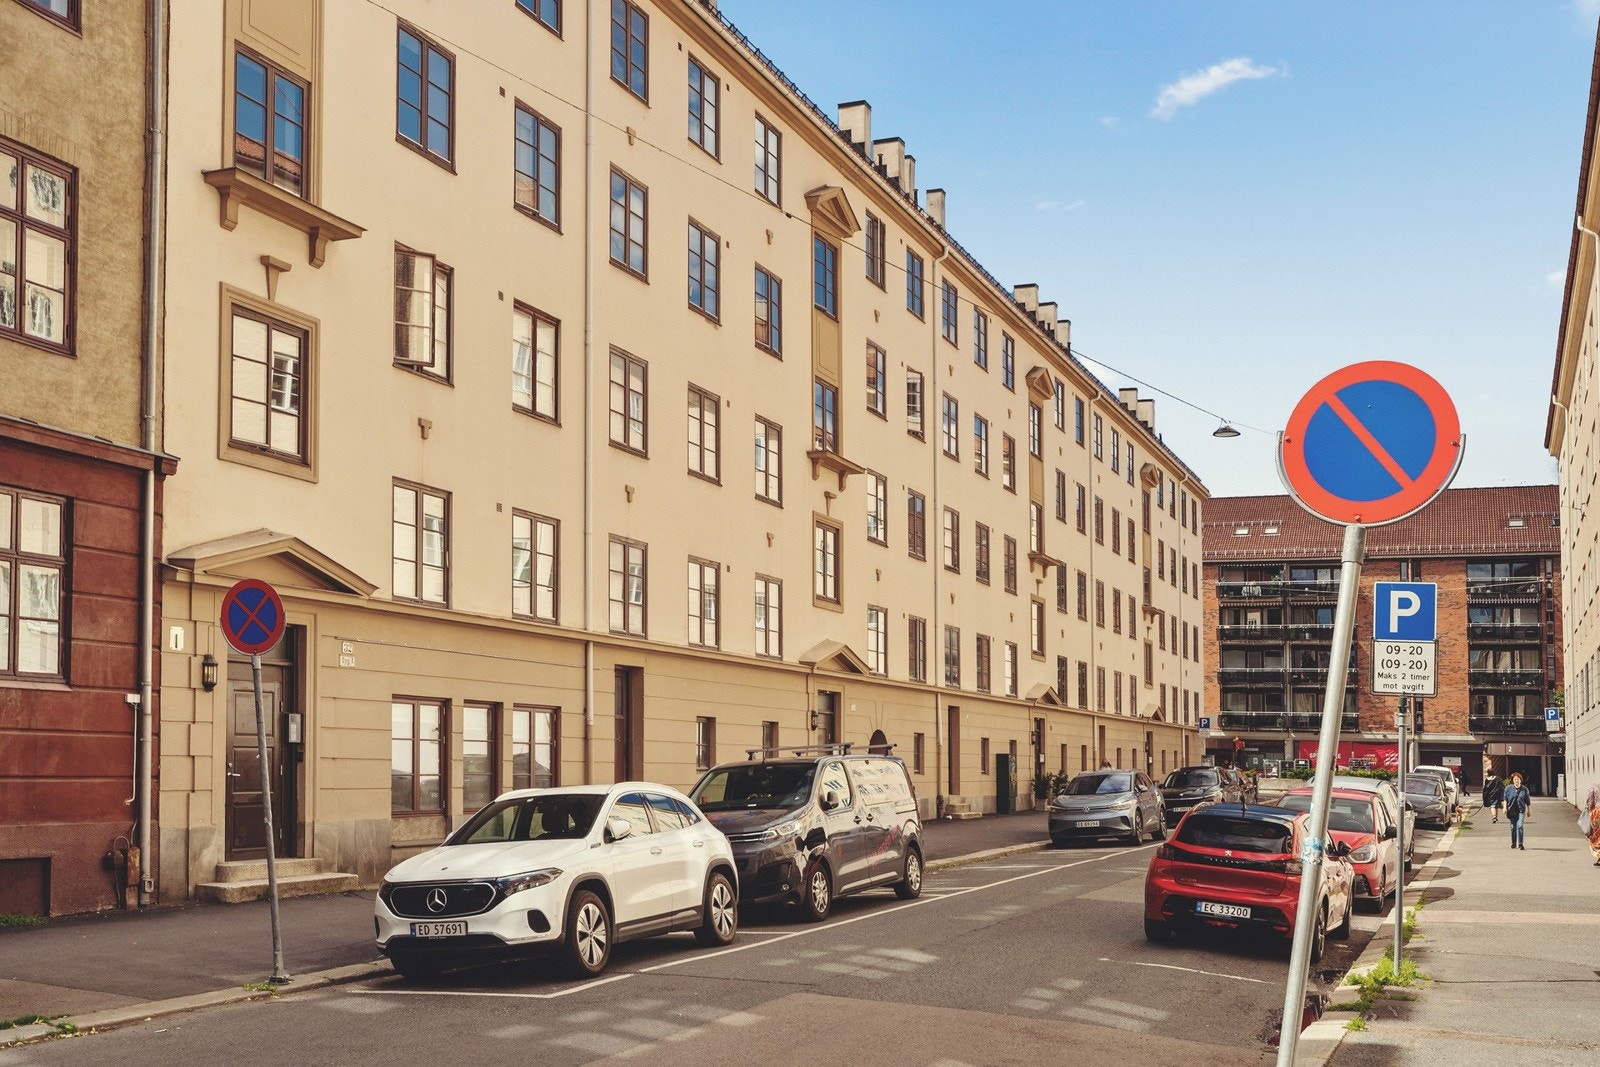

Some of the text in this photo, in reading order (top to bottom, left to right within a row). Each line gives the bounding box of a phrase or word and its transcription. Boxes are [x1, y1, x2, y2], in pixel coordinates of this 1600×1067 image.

[1389, 590, 1421, 633] P
[1377, 672, 1430, 681] Maks 2 timer
[1383, 682, 1424, 691] mot avgift
[1548, 709, 1556, 719] P
[1201, 718, 1208, 728] P
[1203, 903, 1248, 917] EC 33200
[418, 923, 463, 935] ED 57691
